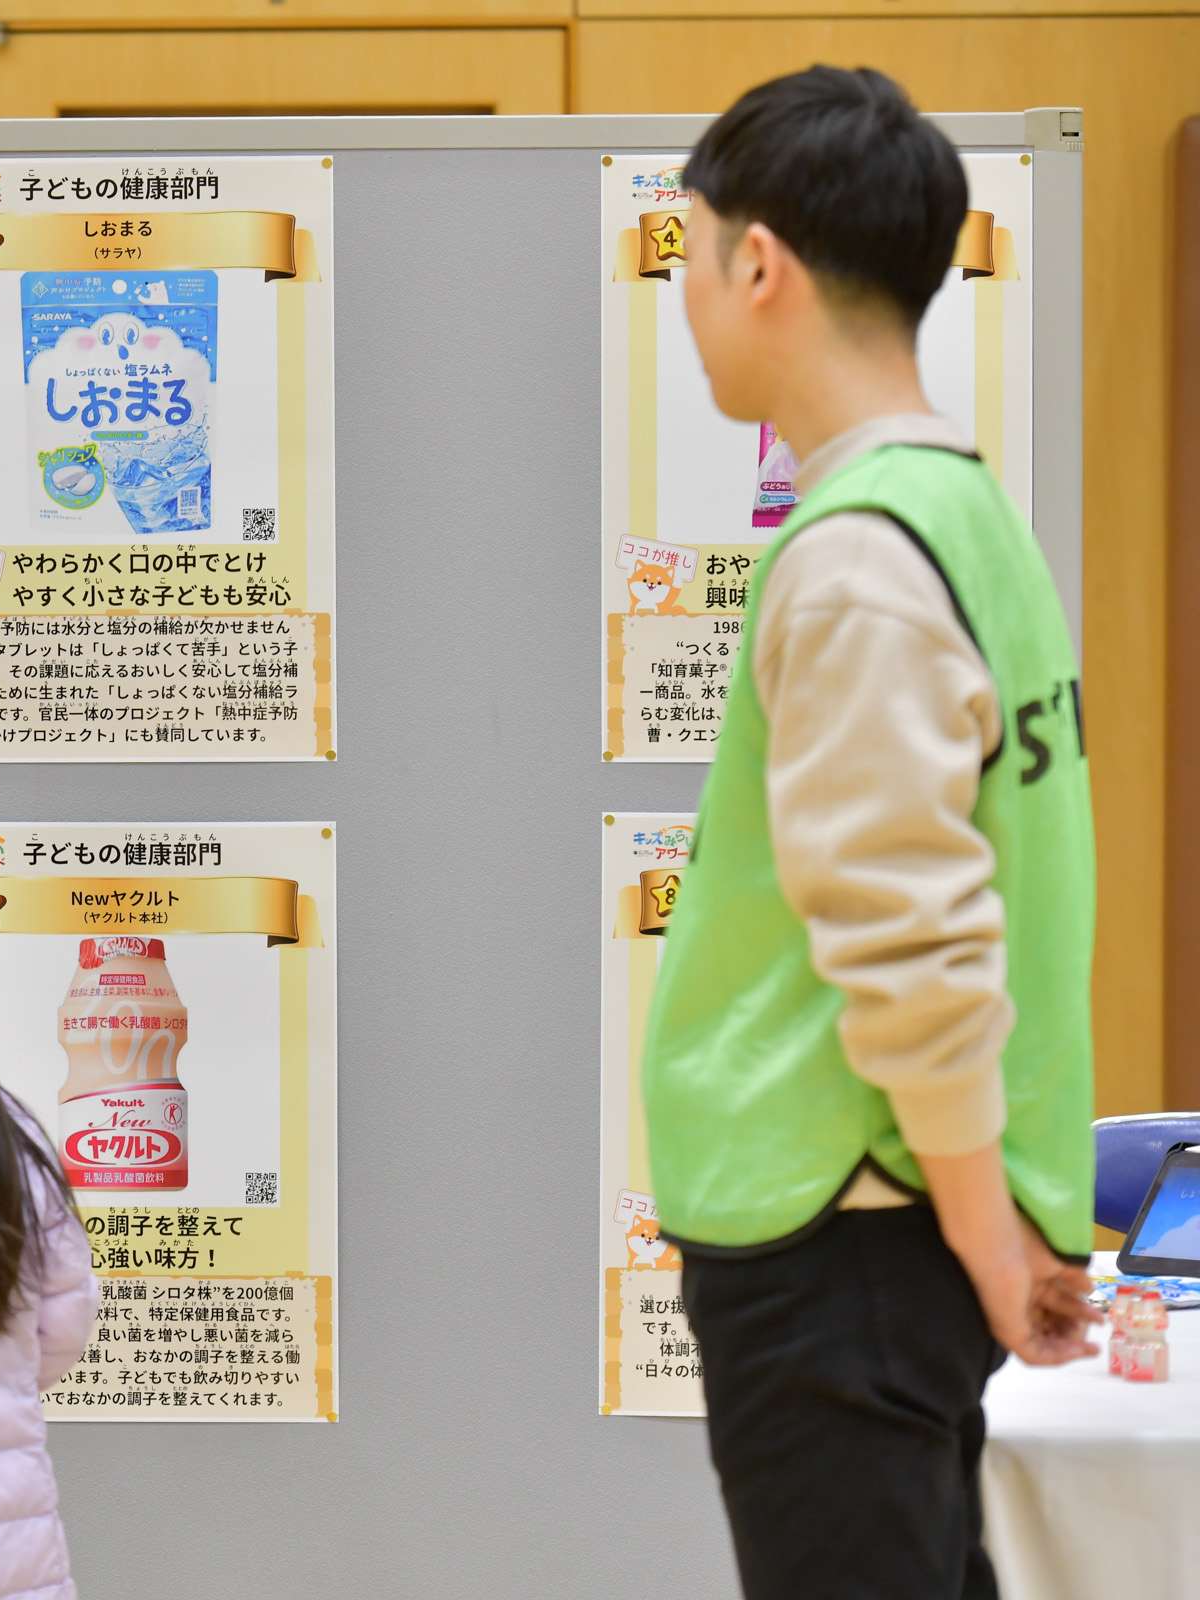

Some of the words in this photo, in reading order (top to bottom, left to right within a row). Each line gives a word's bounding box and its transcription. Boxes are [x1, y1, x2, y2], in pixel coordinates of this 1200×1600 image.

[20, 175, 219, 200] 子どもの健康部門
[85, 221, 152, 237] しおまる
[664, 231, 677, 247] 4
[94, 247, 143, 260] （サラヤ）
[66, 368, 120, 376] しょっぱくない
[125, 364, 172, 376] 塩ラムネ
[47, 377, 192, 427] しおまる
[13, 553, 267, 573] やわらかく口の中でとけ
[623, 542, 692, 569] ココが推し
[706, 555, 762, 575] おや
[13, 585, 291, 606] やすく小さな子どもも安心
[706, 587, 750, 608] 興味
[640, 707, 721, 721] らむ変化は、
[24, 842, 221, 866] 子どもの健康部門
[656, 848, 690, 859] アワー
[71, 891, 179, 907] Newヤクルト
[665, 888, 676, 905] 8
[84, 912, 169, 924] （ヤクルト本社）
[101, 976, 144, 984] 特定保健用食品
[64, 1016, 160, 1029] 生きて腸で働く乳酸菌
[101, 1099, 145, 1107] Yakult
[88, 1110, 152, 1128] New
[88, 1136, 161, 1159] ヤクルト
[84, 1173, 164, 1183] 乳製品乳酸菌飲料
[85, 1215, 243, 1237] の調子を整えて
[91, 1247, 215, 1269] 心強い味方！
[99, 1329, 293, 1343] 良い菌を増やし悪い菌を減ら
